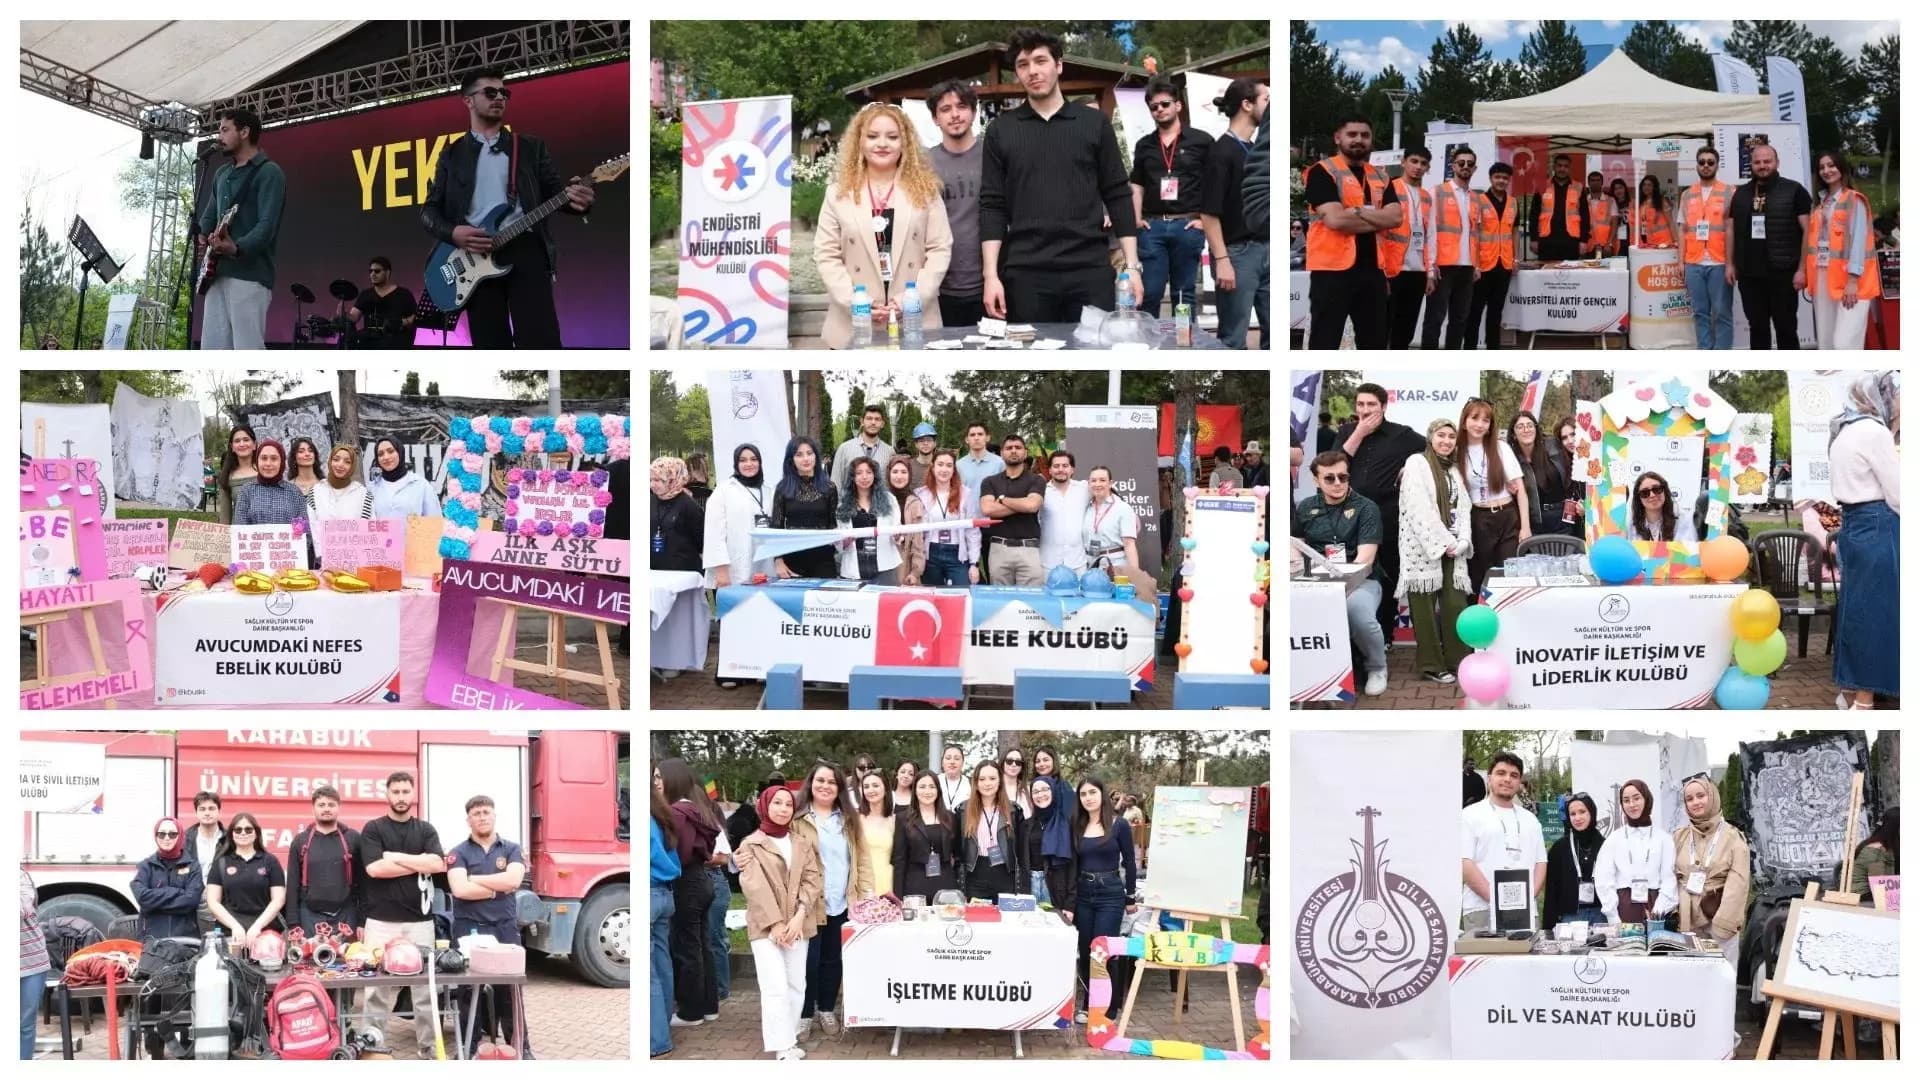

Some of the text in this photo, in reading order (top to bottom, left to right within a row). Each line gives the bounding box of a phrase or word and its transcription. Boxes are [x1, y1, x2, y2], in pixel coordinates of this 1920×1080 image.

[352, 124, 511, 211] YEK
[702, 212, 761, 232] ENDÜSTRİ
[689, 237, 778, 257] MÜHENDİSLİĞİ
[716, 261, 746, 274] KULÜBÜ
[1509, 294, 1617, 308] ÜNİVERSİTELİ AKTİF GENÇLİK
[1547, 308, 1577, 319] KULÜBÜ
[1396, 389, 1459, 402] KAR-SAV
[1120, 494, 1150, 504] aker
[551, 537, 598, 556] AŞK
[491, 548, 621, 574] ANNE SÜTÜ
[443, 565, 585, 606] AVUCUMDAKİ
[781, 621, 871, 639] İEEE KULÜBÜ
[1028, 626, 1128, 650] KULÜBÜ
[195, 637, 363, 653] AVUCUMDAKİ NEFES
[1515, 643, 1706, 665] İNOVATİF İLETİŞİM VE
[216, 658, 342, 676] EBELİK KULÜBÜ
[1532, 664, 1688, 687] LİDERLİK KULÜBÜ
[31, 774, 41, 784] VE
[200, 768, 390, 799] ÜNİVERSİTES
[1297, 878, 1358, 1004] KARABÜK ÜNİVERSİTESİ
[1387, 880, 1444, 1005] DİL VE SANAT KULÜBÜ
[887, 978, 1032, 1003] İŞLETME KULÜBÜ
[1487, 1004, 1697, 1028] DİL VE SANAT KULÜBÜ
